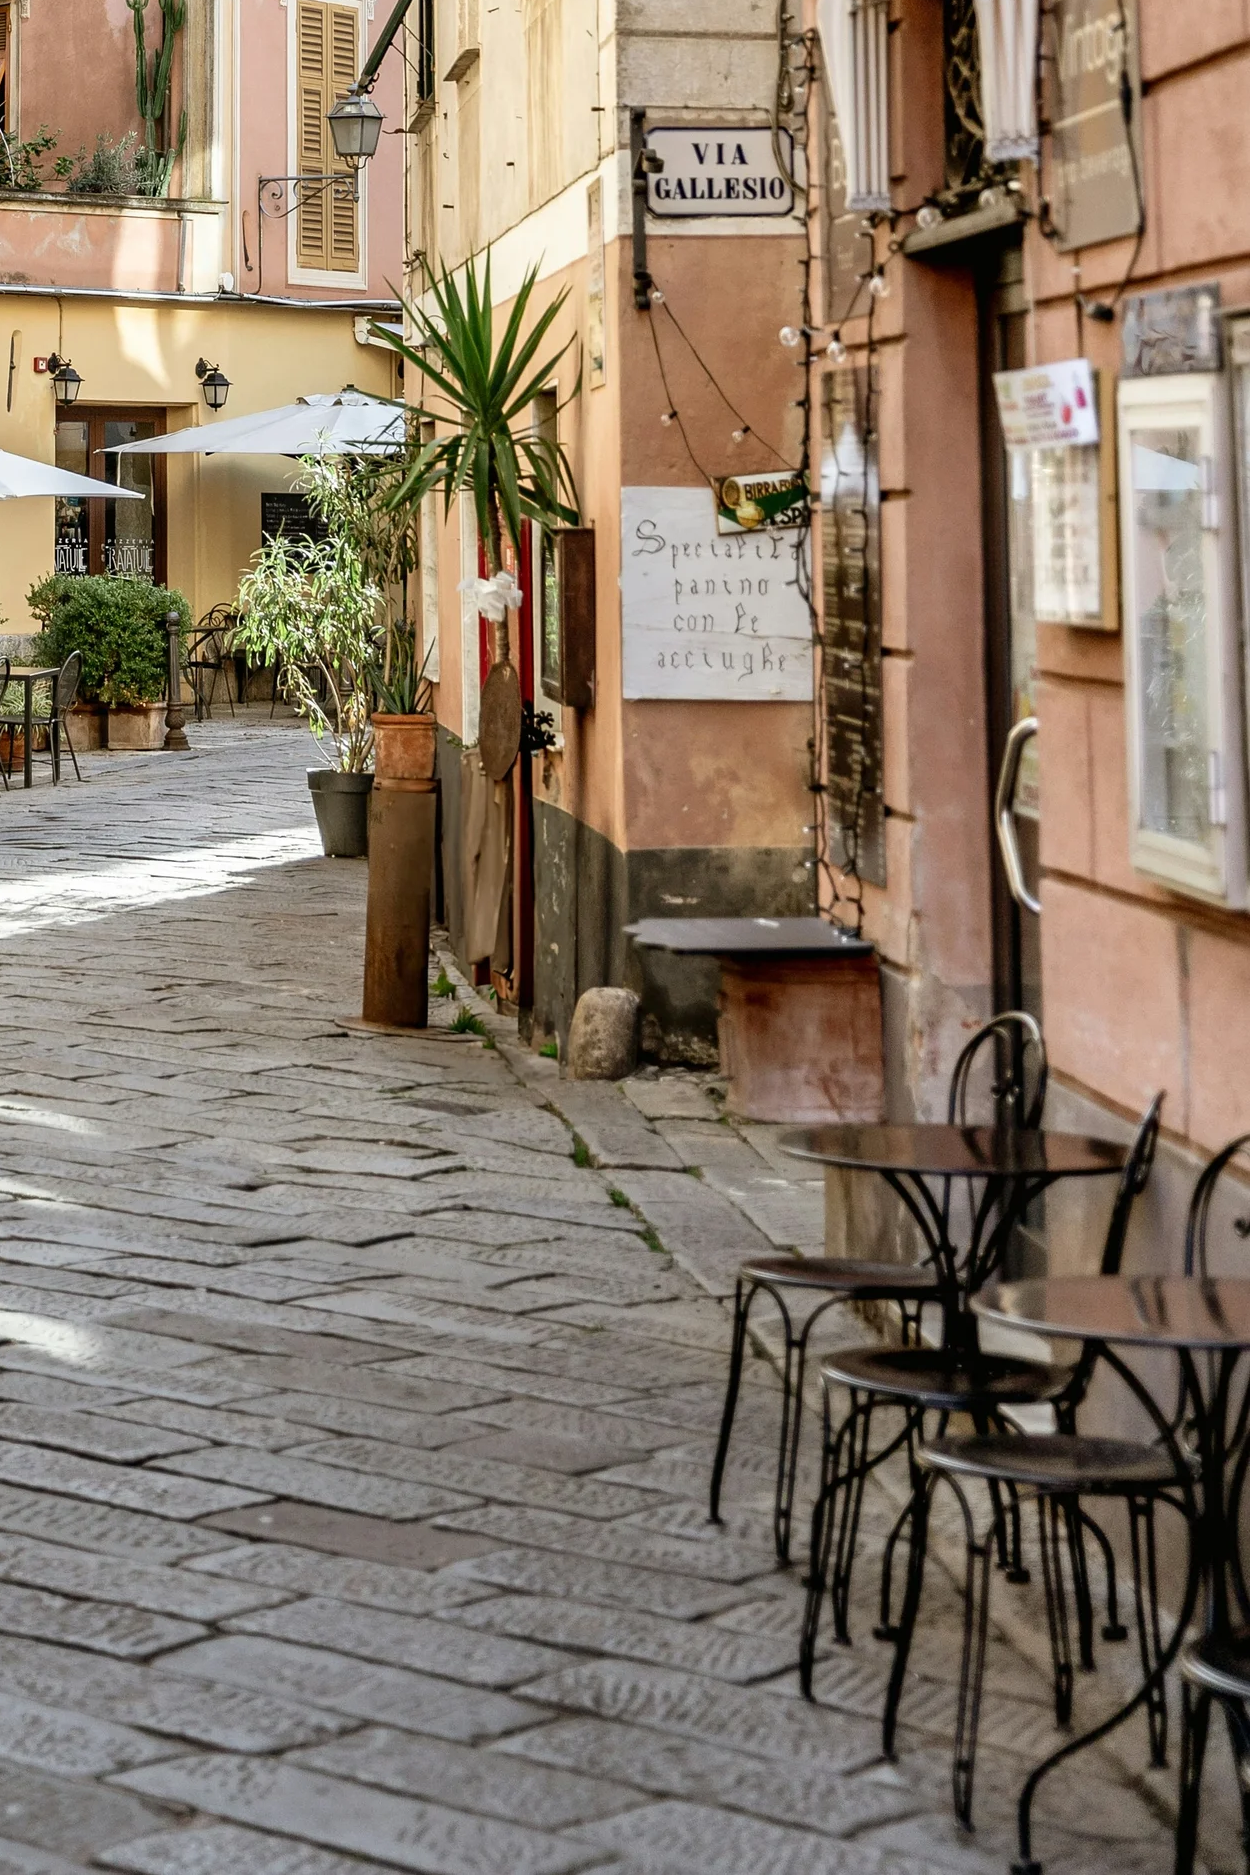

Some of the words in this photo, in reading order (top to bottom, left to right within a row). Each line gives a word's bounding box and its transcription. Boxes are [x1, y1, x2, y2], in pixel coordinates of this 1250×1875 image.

[692, 143, 748, 165] VIA
[654, 177, 785, 200] GALLESIO
[744, 480, 780, 501] BIRRA
[673, 578, 770, 605] panino
[673, 613, 715, 632] con
[657, 643, 786, 681] acciughe
